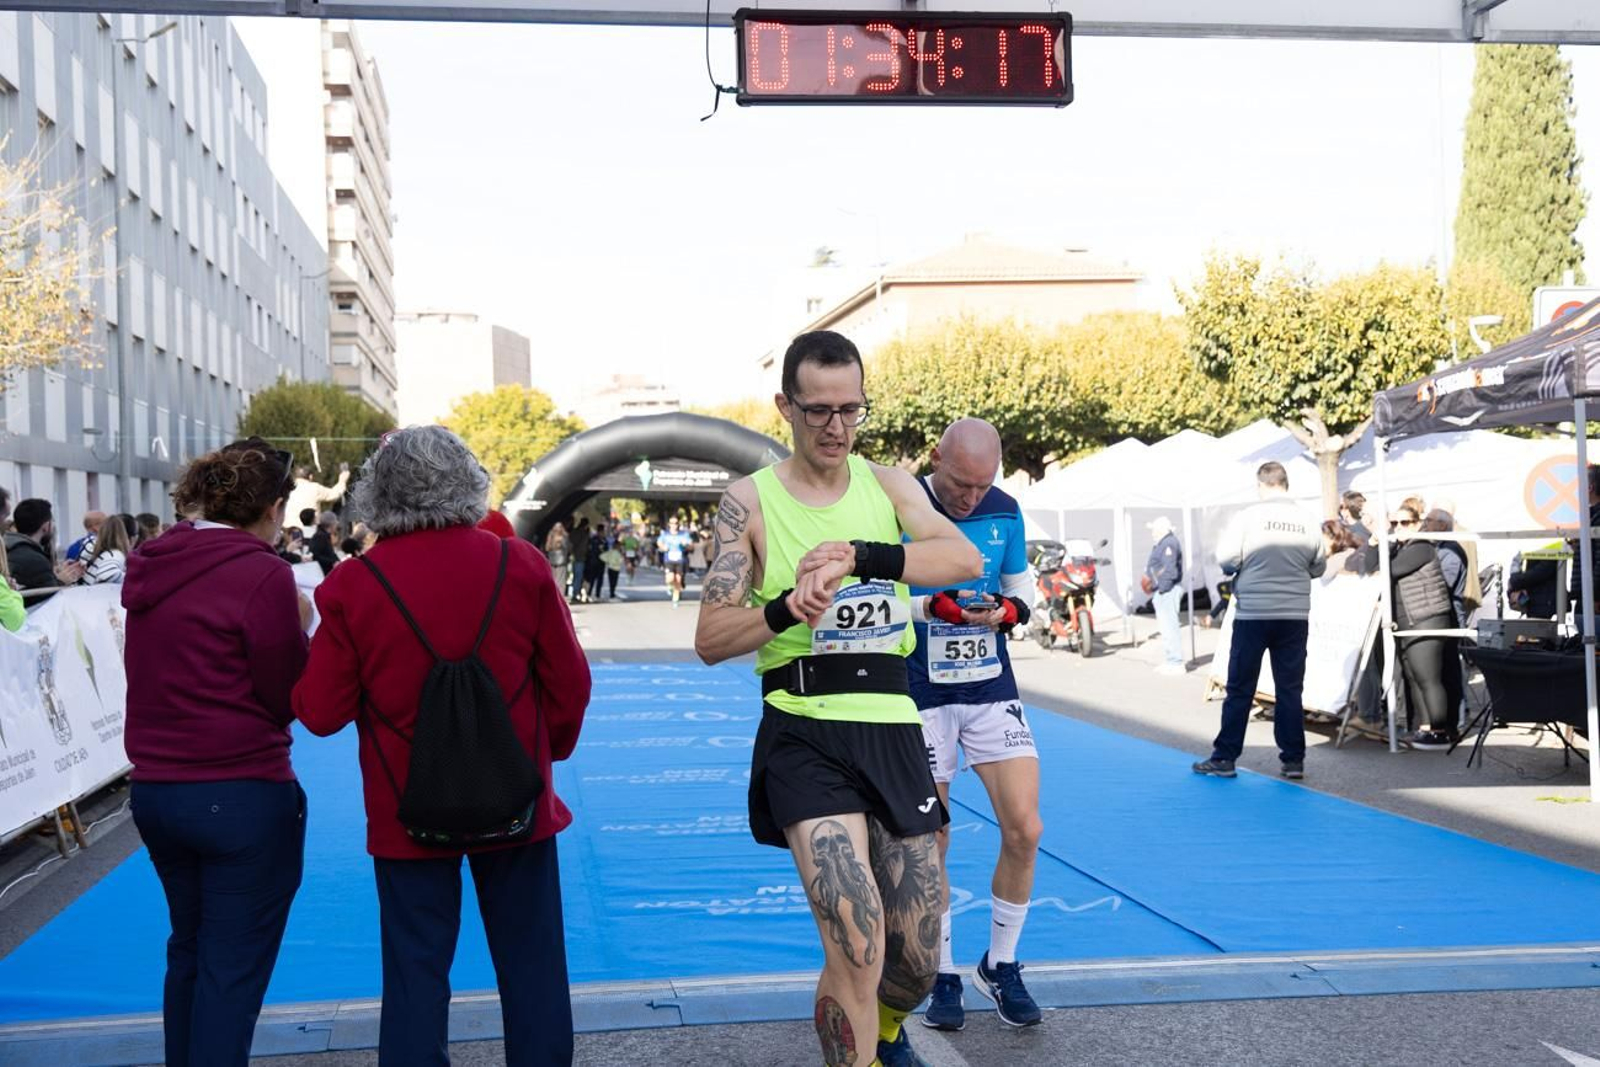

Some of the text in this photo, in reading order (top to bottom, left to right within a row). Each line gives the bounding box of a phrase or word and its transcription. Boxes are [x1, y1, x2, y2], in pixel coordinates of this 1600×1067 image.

[751, 22, 1052, 90] 01:34:17
[836, 599, 891, 629] 921
[945, 638, 987, 660] 536
